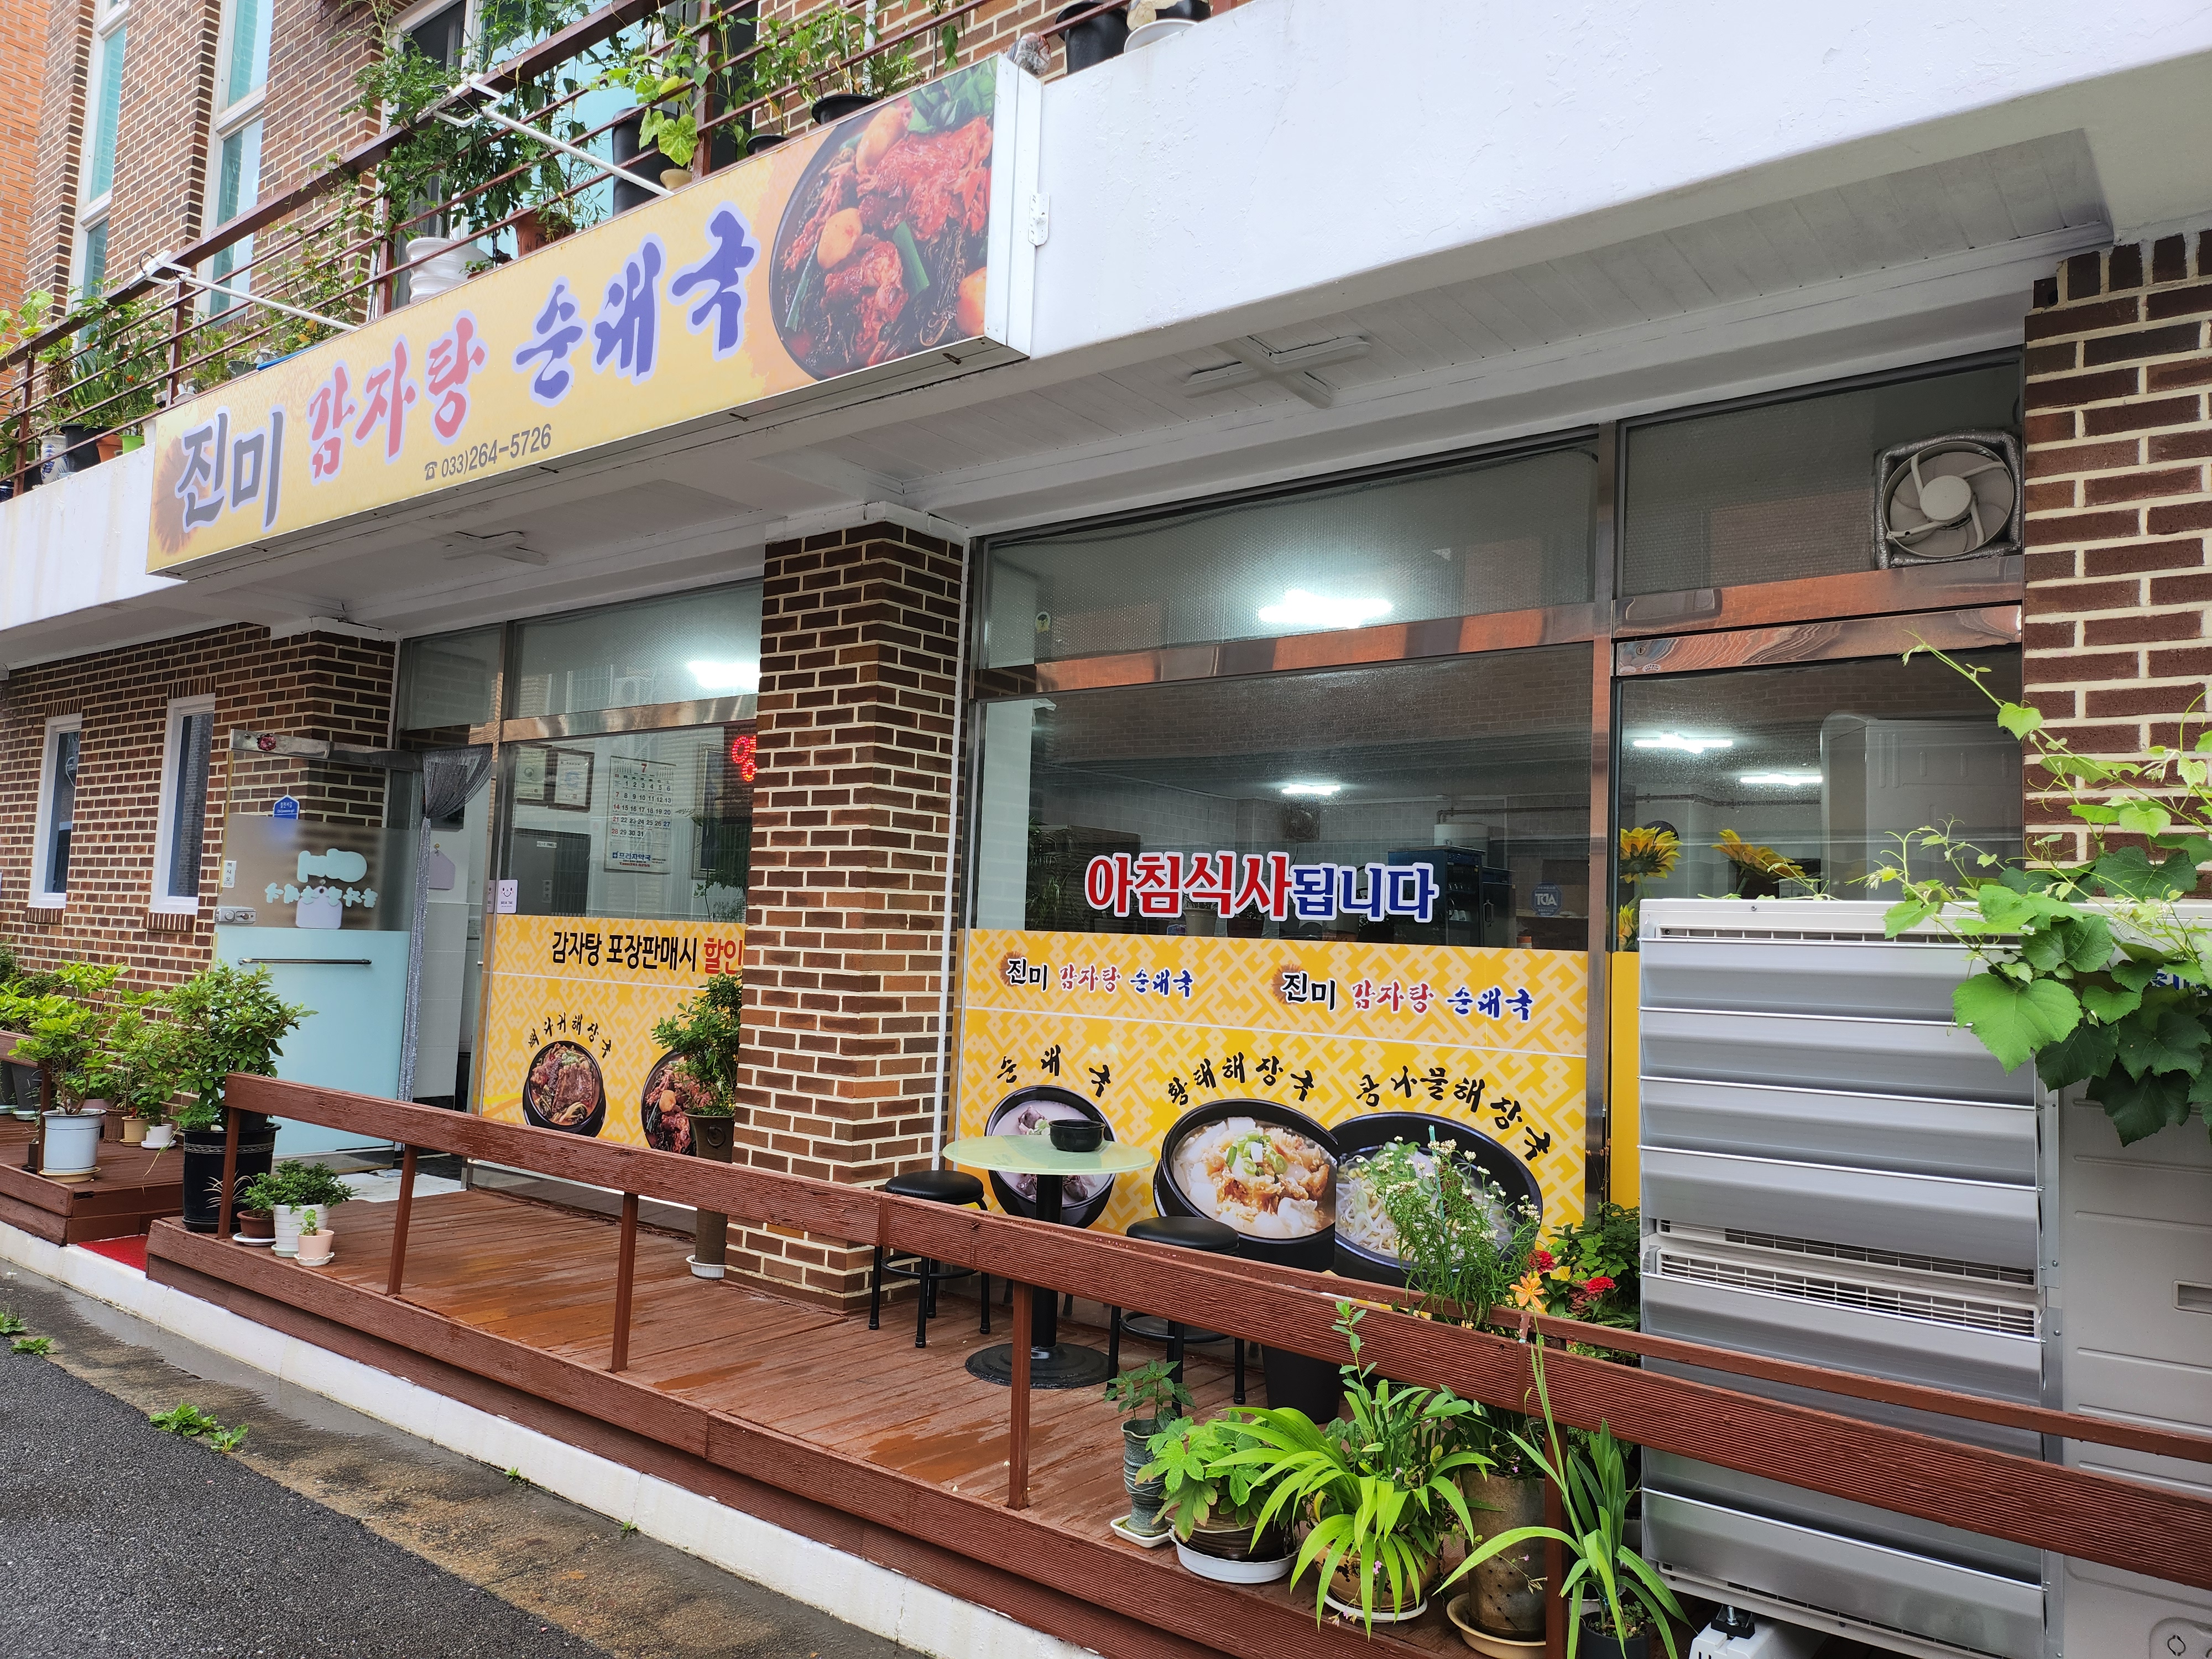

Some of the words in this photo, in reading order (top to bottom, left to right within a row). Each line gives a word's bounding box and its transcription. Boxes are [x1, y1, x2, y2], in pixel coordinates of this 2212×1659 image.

[177, 410, 284, 529] 진미
[310, 317, 487, 480] 감자탕
[516, 210, 758, 399] 순대국
[442, 423, 552, 478] 033)264-5726
[641, 763, 648, 773] 7
[619, 852, 651, 861] 프라자약국
[1087, 853, 1437, 920] 아침식사됩니다
[552, 931, 602, 967] 감자탕
[606, 934, 697, 972] 포장판매시
[704, 937, 743, 974] 할인
[1007, 958, 1048, 990] 진미
[1061, 965, 1120, 992] 감자탕
[1130, 968, 1193, 997] 순대국
[1282, 973, 1335, 1010] 진미
[1353, 980, 1434, 1014] 감자탕
[1447, 987, 1533, 1021] 순대국
[528, 1011, 612, 1059] 뼈다귀해장국
[997, 1044, 1112, 1099] 순대국
[1167, 1052, 1316, 1106] 황태해장국
[1355, 1065, 1551, 1161] 콩나물해장국
